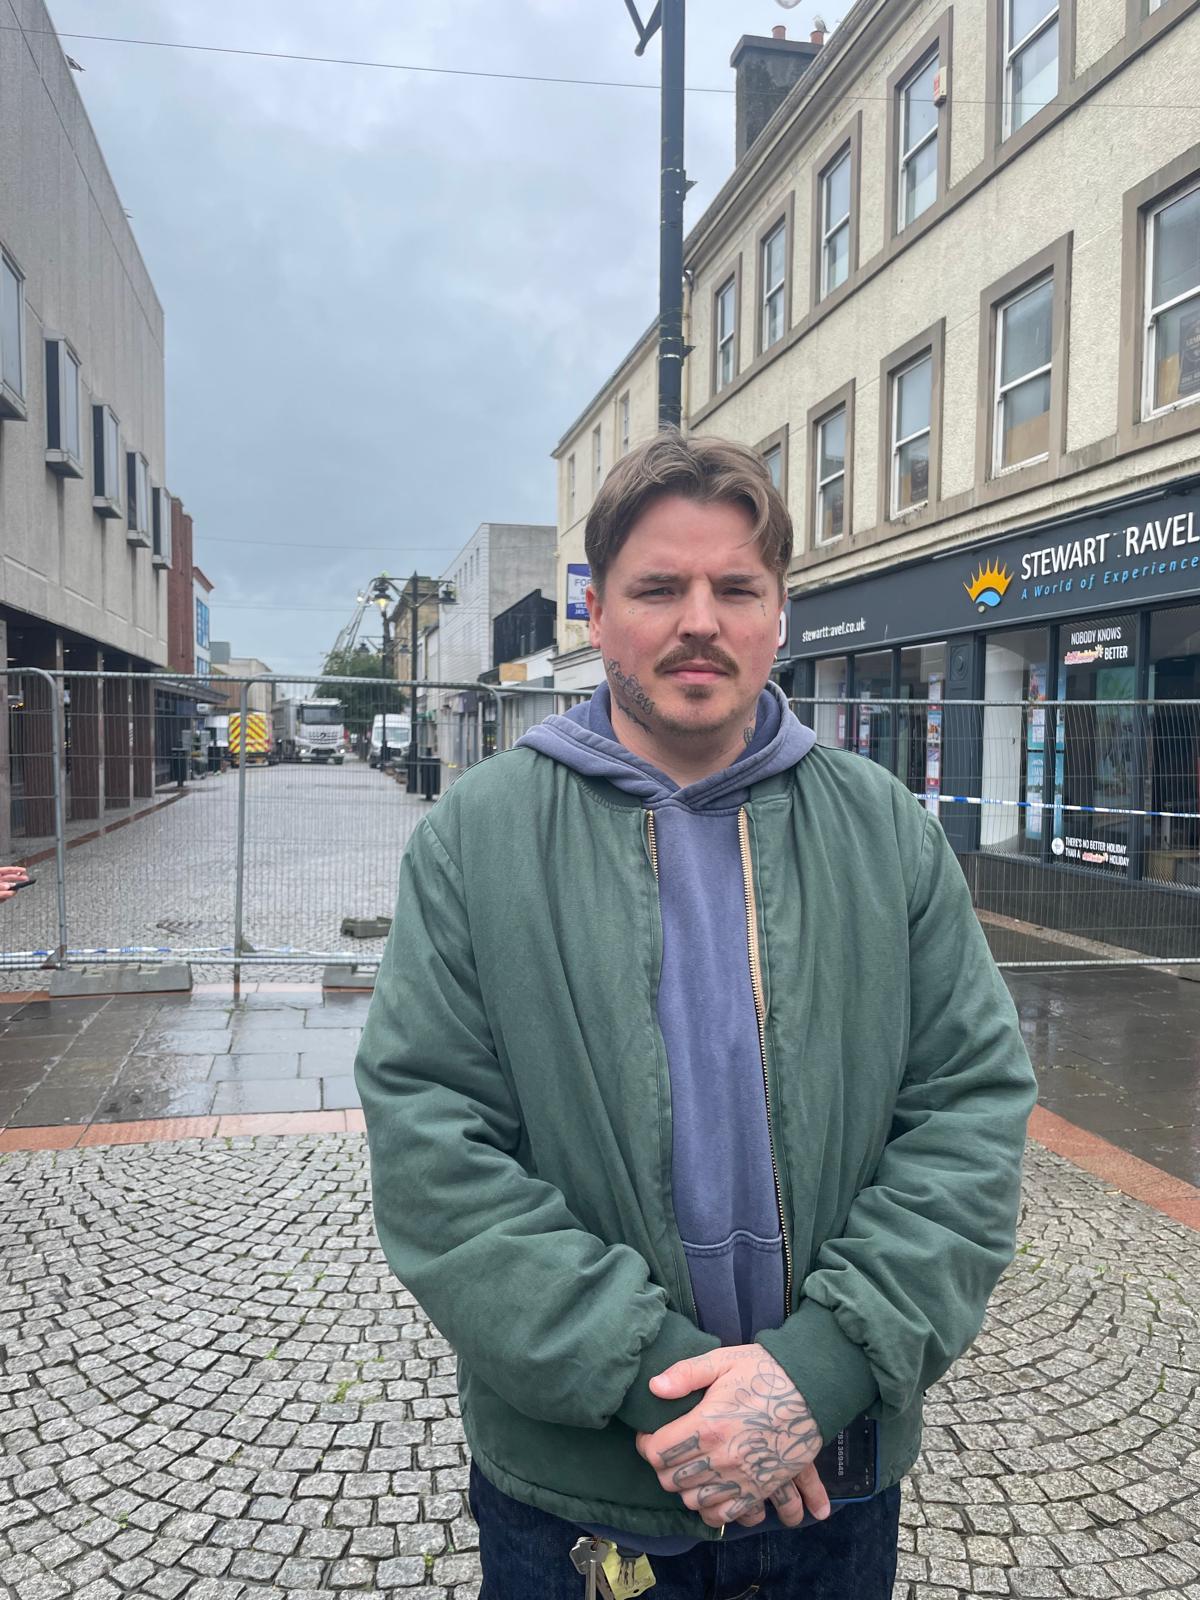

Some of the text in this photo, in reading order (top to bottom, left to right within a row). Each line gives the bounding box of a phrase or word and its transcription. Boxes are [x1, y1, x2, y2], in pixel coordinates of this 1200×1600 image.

[1021, 512, 1200, 580] STEWART RAVEL
[1021, 556, 1200, 600] A World of Experience
[802, 617, 866, 642] stewarttavel.co.uk
[1071, 626, 1121, 645] NOBODY KNOWS
[1104, 645, 1128, 660] BETTER
[1065, 836, 1127, 855] THERE'S NO BETTER HOLIDAY
[1109, 855, 1130, 867] HOLIDAY
